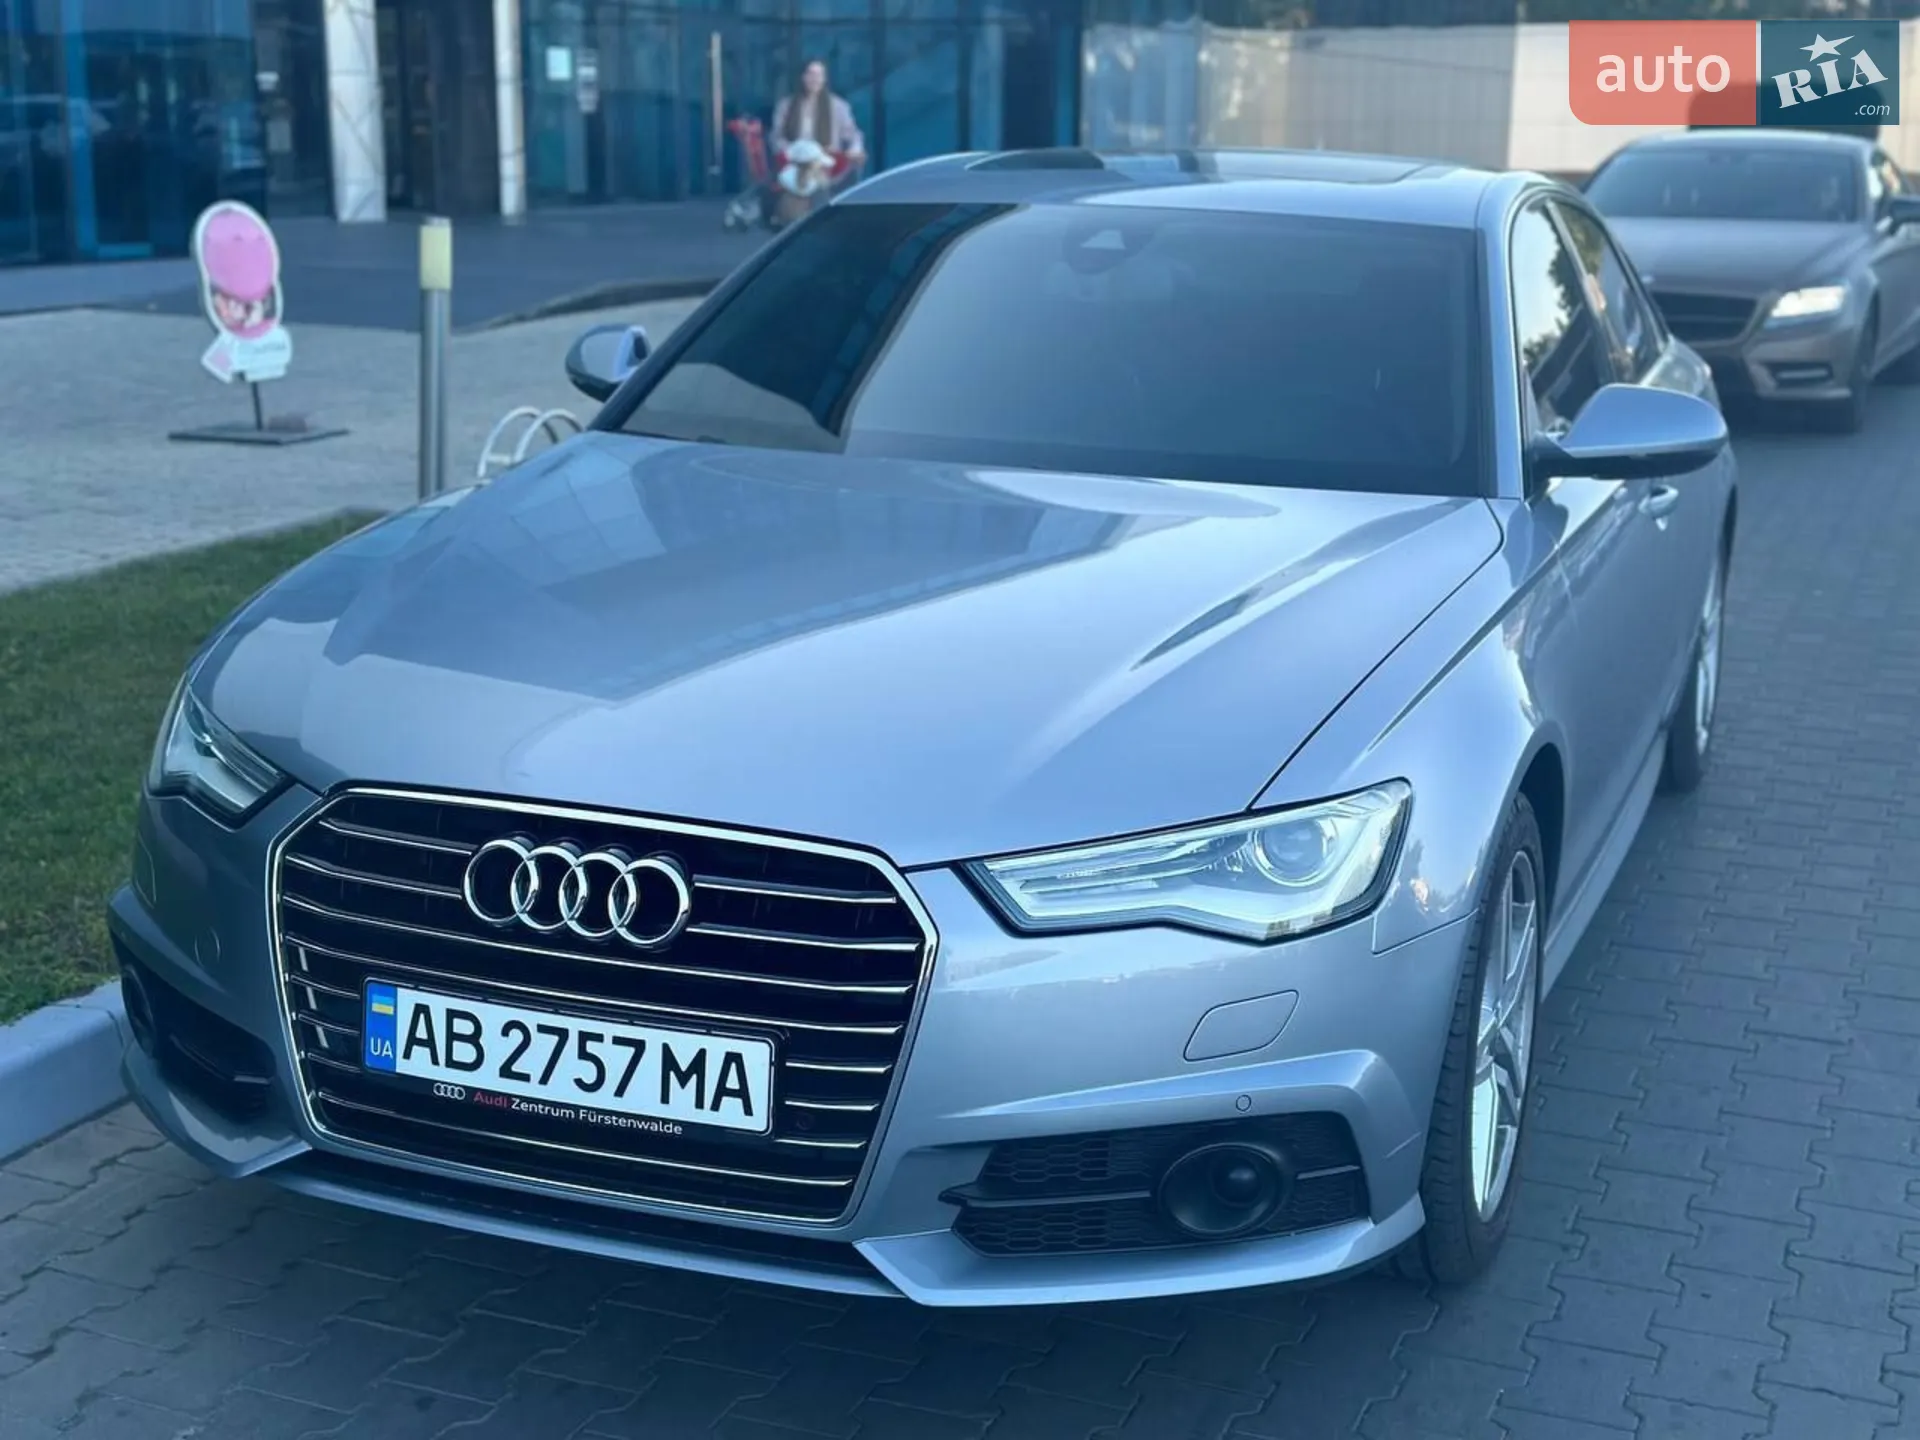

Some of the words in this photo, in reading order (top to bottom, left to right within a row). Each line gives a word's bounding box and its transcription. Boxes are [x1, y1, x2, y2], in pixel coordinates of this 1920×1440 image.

[369, 1037, 394, 1060] UA
[402, 1003, 486, 1073] AB
[498, 1020, 647, 1099] 2757
[660, 1041, 754, 1118] MA
[473, 1090, 508, 1109] Audi
[511, 1098, 576, 1120] Zentrum
[579, 1108, 683, 1136] Fürstenwalde
